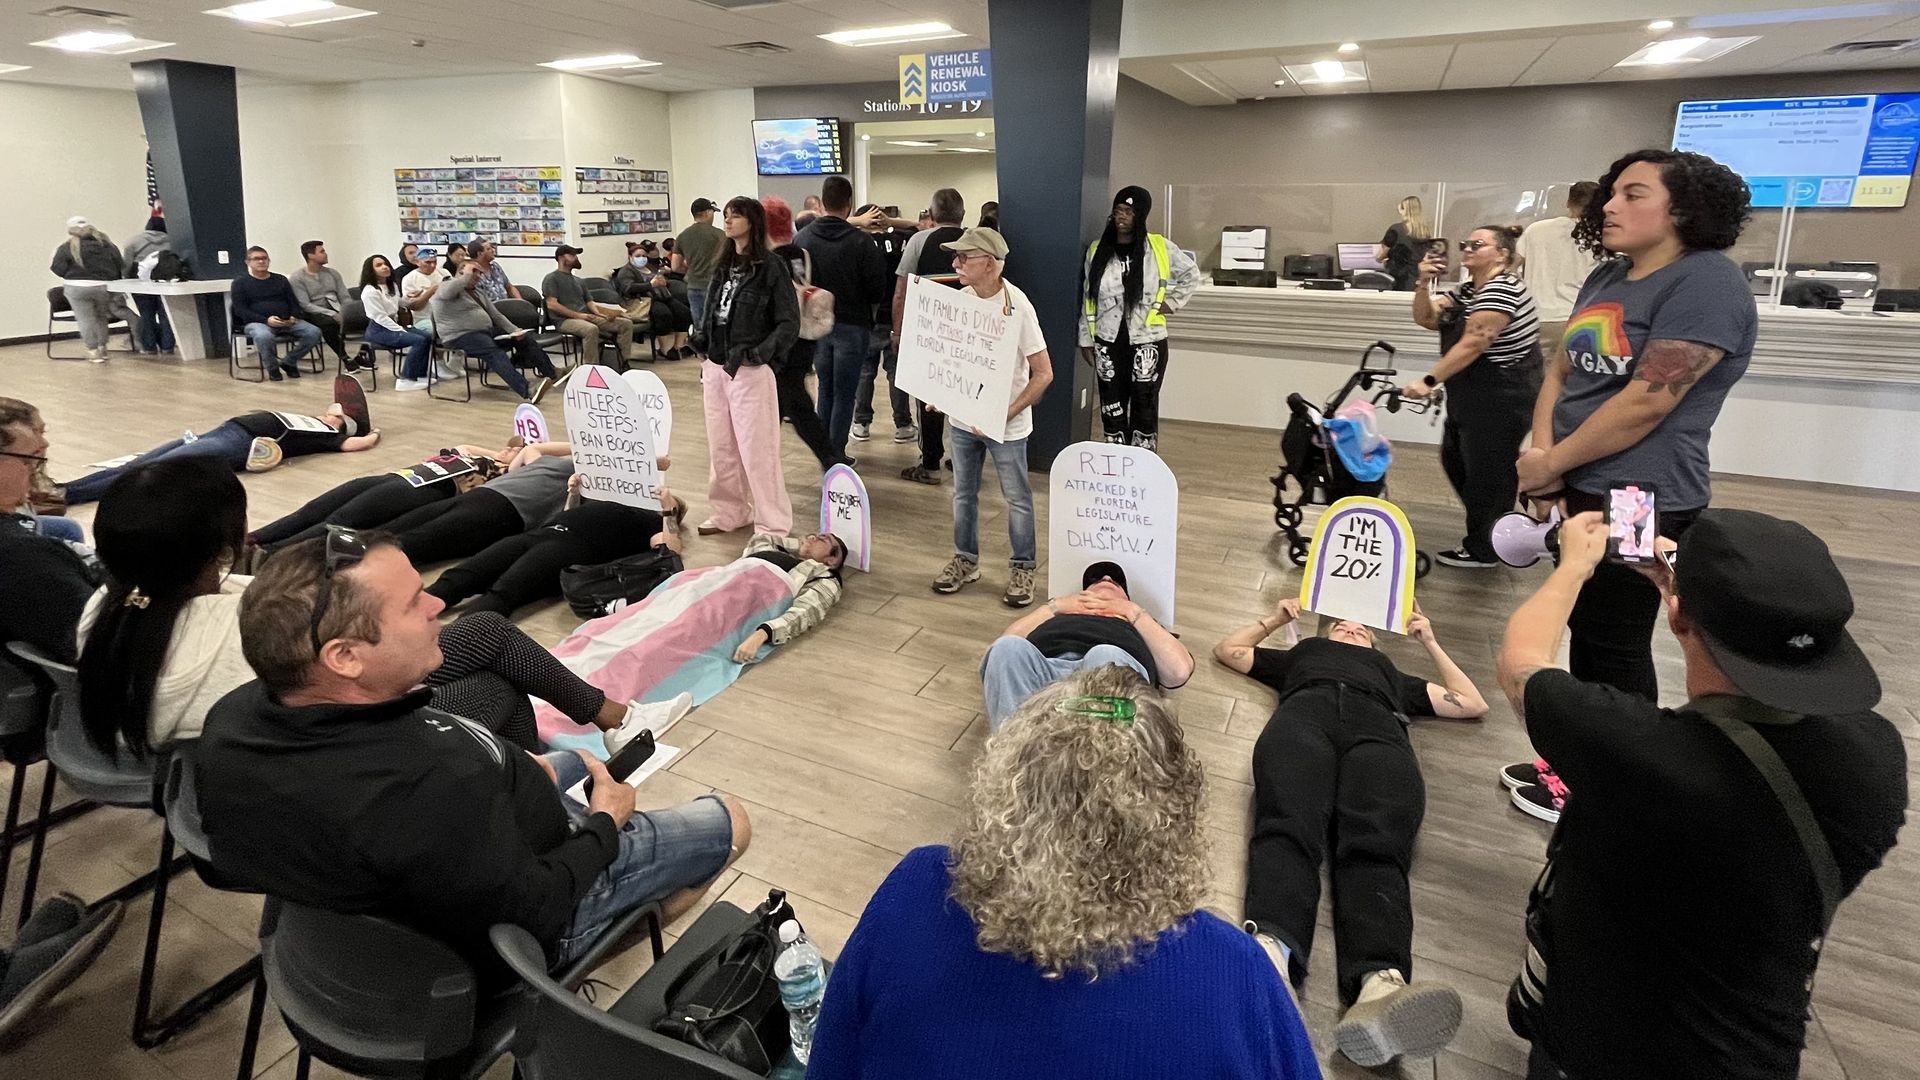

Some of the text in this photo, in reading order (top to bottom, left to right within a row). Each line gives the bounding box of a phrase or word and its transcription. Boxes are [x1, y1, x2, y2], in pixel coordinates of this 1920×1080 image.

[930, 52, 979, 66] VEHICLE
[930, 66, 986, 80] RENEWAL
[930, 80, 966, 93] KIOSK
[864, 100, 912, 112] Stations
[918, 102, 938, 113] 10
[918, 294, 930, 313] MY
[917, 314, 993, 351] FROM ATTACKS BY THE
[916, 334, 945, 354] FLORIDA
[1580, 352, 1634, 375] GAY
[566, 389, 628, 414] HITLER'S
[588, 412, 638, 434] STEPS:
[580, 431, 603, 447] BAN
[606, 434, 645, 456] BOOKS
[574, 452, 651, 475] 2 IDENTIFY
[1080, 451, 1134, 479] R.I.P.
[578, 472, 656, 500] QUEER PEOPLE
[1064, 480, 1146, 500] ATTACKED BY
[828, 491, 862, 509] REMEMBER
[1095, 497, 1138, 511] FLORIDA
[837, 506, 851, 520] ME
[1076, 507, 1152, 526] LEGISLATURE
[1350, 516, 1376, 538] I'M
[1338, 533, 1382, 556] THE
[1330, 554, 1382, 580] 20%
